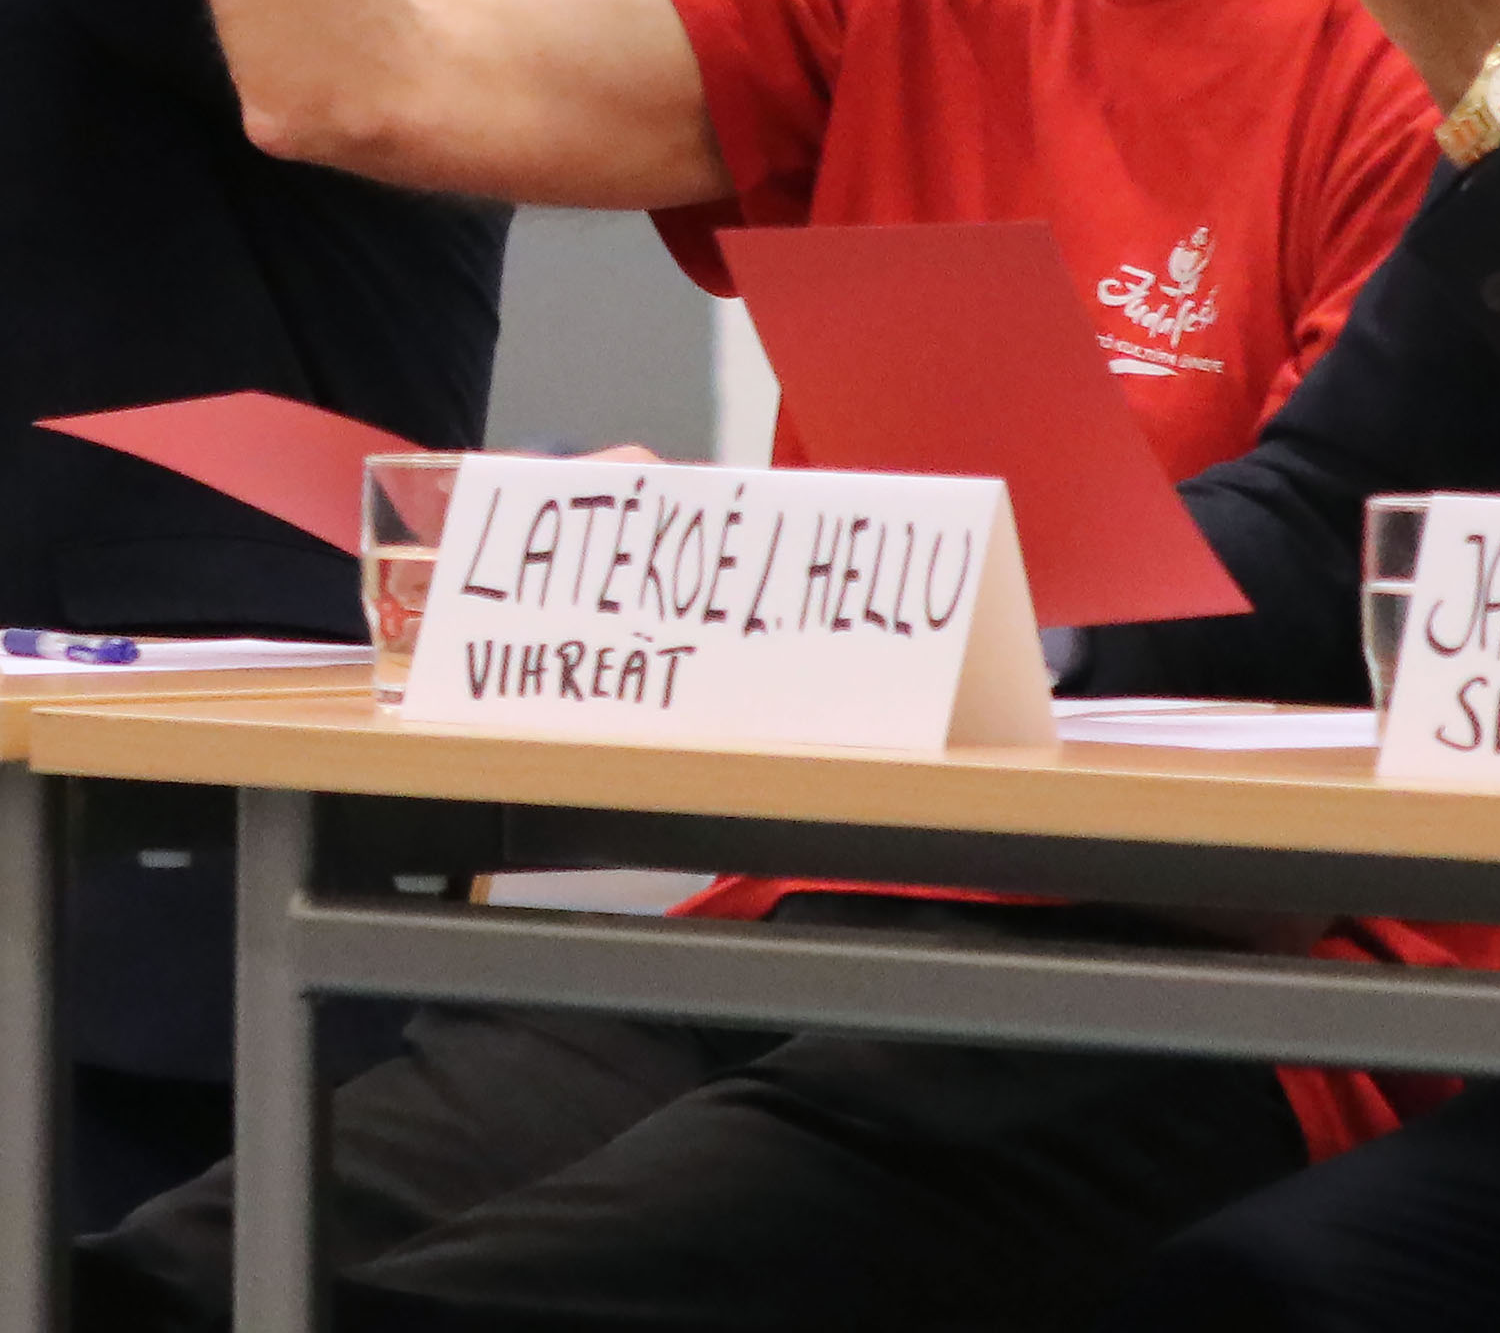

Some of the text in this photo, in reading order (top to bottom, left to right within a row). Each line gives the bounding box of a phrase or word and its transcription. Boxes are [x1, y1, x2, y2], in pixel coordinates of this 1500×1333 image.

[460, 476, 744, 624] LATÉKOÉ
[798, 511, 972, 637] HELLU
[466, 631, 697, 708] VIHREÄT
